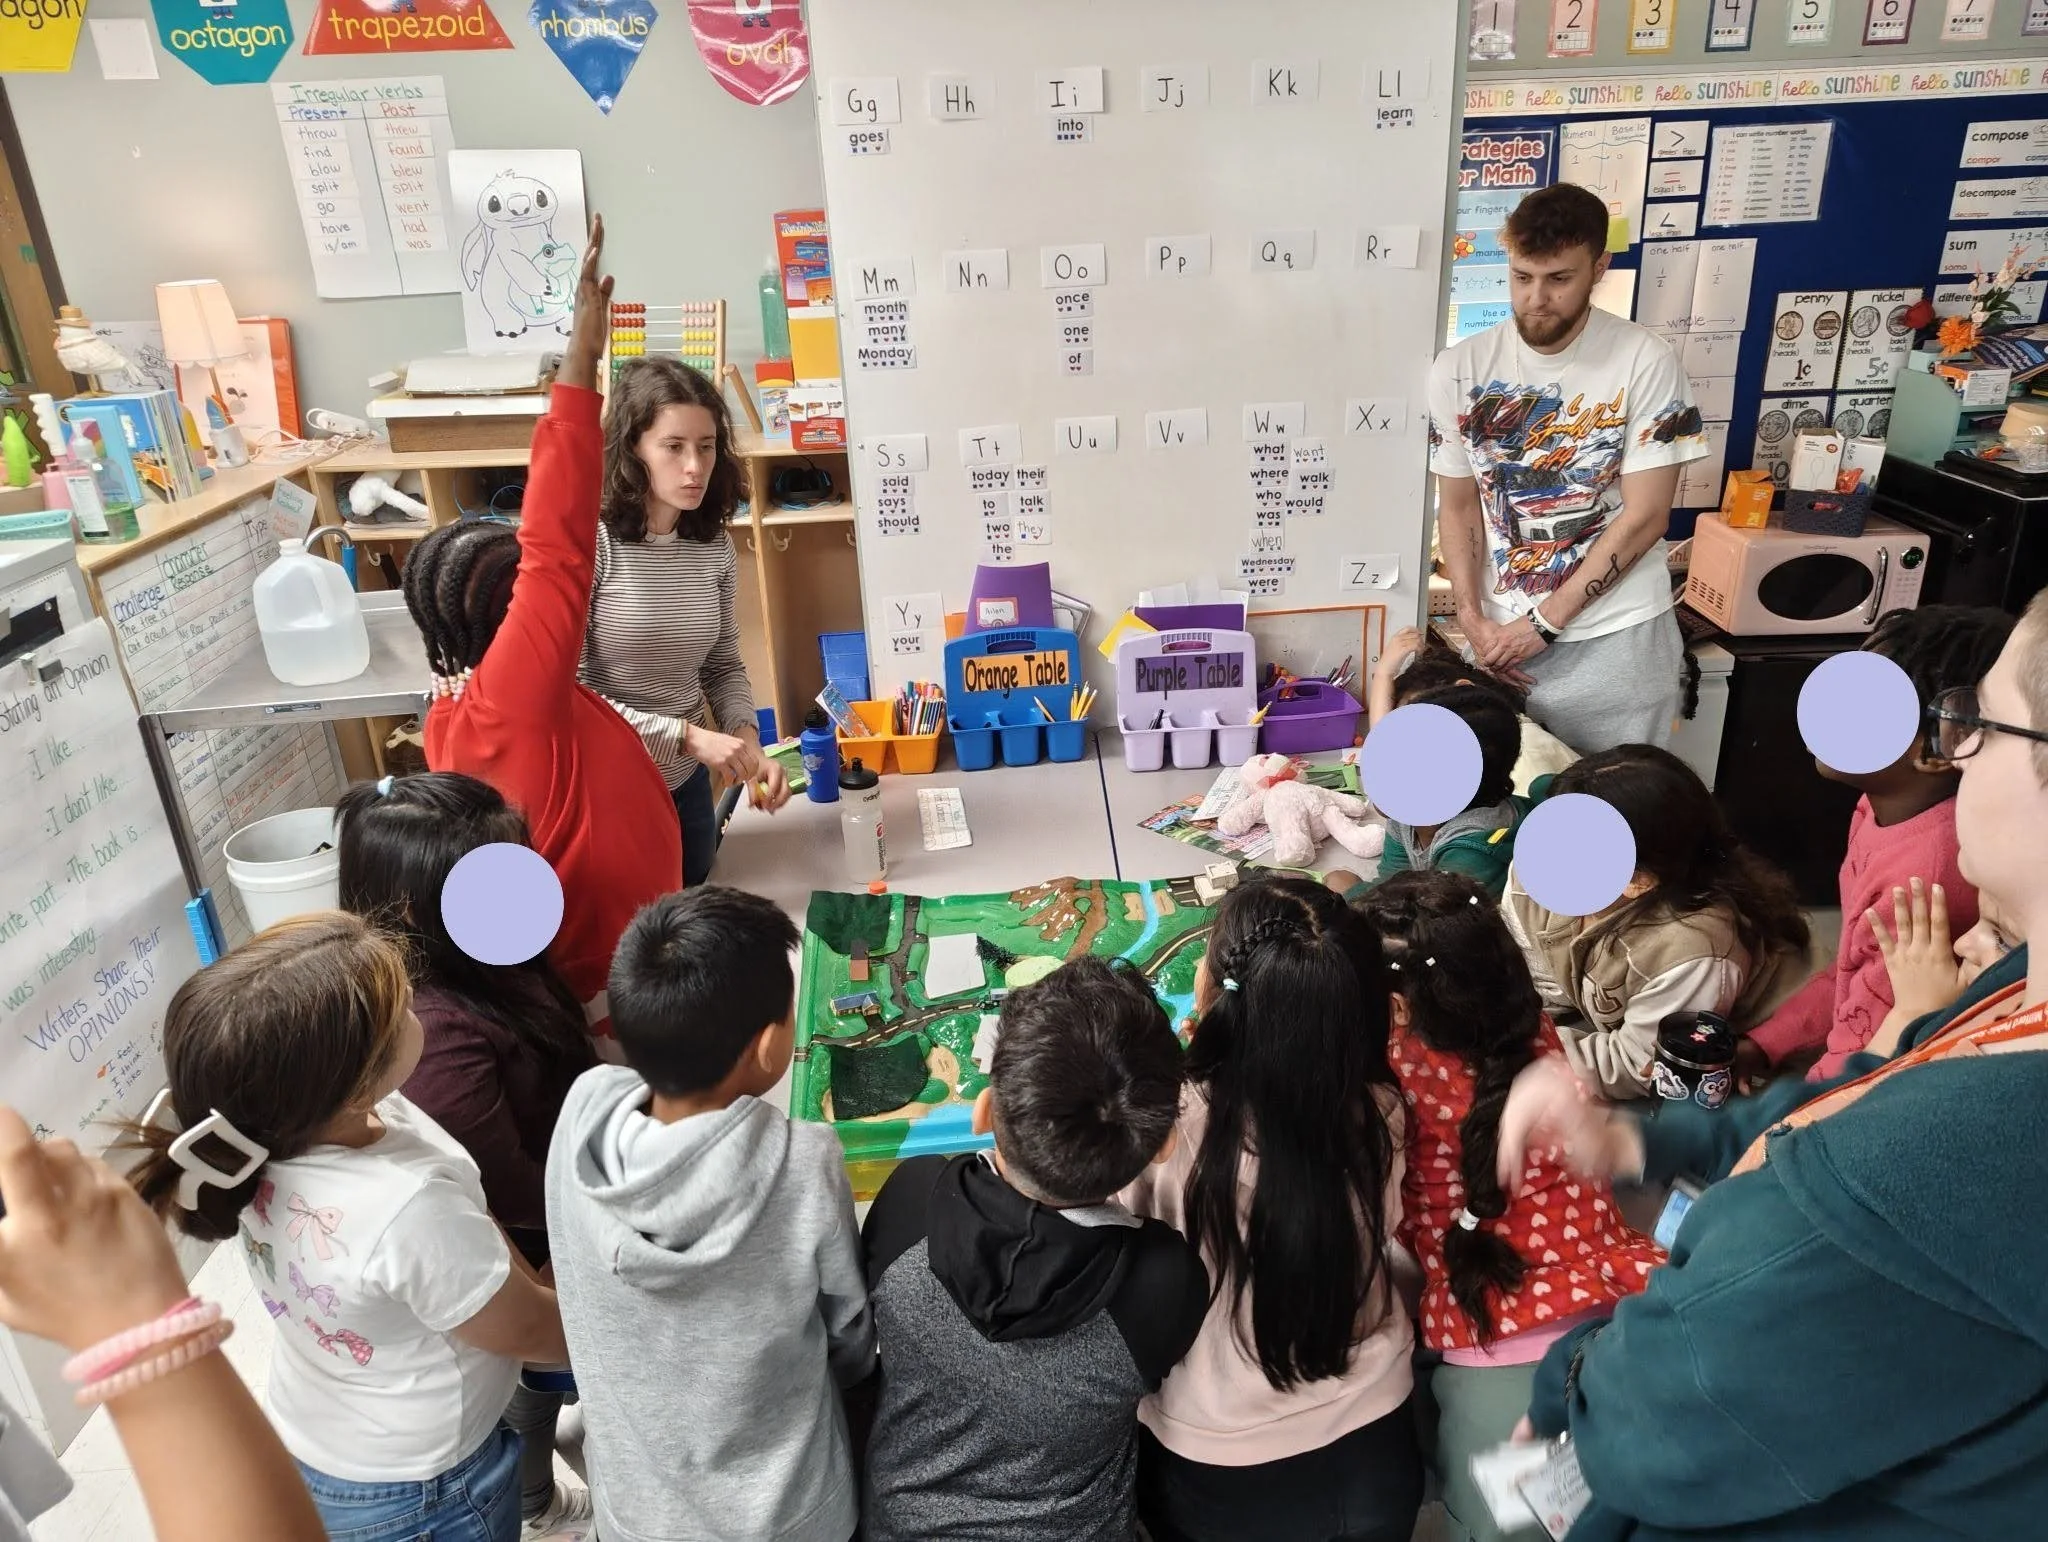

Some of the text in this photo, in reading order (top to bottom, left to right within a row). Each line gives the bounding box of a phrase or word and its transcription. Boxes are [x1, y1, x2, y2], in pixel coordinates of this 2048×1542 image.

[1566, 0, 1581, 28] 2
[1645, 0, 1661, 25] 3
[328, 10, 486, 49] trapezoid
[541, 11, 648, 39] rhombus
[171, 23, 286, 58] octagon
[727, 34, 792, 67] oval
[1525, 68, 2030, 106] hello sunshine hello sunshine hello sunshine hello sunshine
[289, 84, 369, 106] Irregular
[288, 102, 416, 120] Present Past
[1377, 106, 1414, 122] learn
[386, 123, 419, 135] threw
[1057, 118, 1084, 133] into
[1611, 125, 1636, 137] Base
[299, 126, 338, 140] throw
[849, 130, 885, 148] goes
[1971, 129, 2030, 145] compose
[304, 146, 332, 159] find
[391, 163, 422, 178] blew
[1483, 163, 1536, 186] Math
[312, 180, 339, 195] split
[1959, 186, 2018, 199] decompose
[318, 201, 336, 216] go
[397, 202, 430, 214] went
[1475, 204, 1509, 217] fingers
[320, 220, 351, 235] have
[401, 218, 428, 233] had
[407, 239, 432, 250] was
[1949, 238, 1978, 251] sum
[1054, 290, 1091, 306] once
[1794, 293, 1834, 306] penny
[1871, 291, 1906, 303] nickel
[864, 301, 908, 314] month
[868, 323, 908, 338] many
[1063, 324, 1090, 336] one
[858, 346, 914, 360] Monday
[1067, 352, 1083, 365] of
[1781, 399, 1810, 410] dime
[1848, 395, 1893, 407] quarter
[1253, 443, 1286, 455] what
[972, 468, 1046, 483] today their
[1250, 467, 1290, 480] where
[1299, 471, 1330, 484] walk
[882, 475, 910, 488] said
[1020, 494, 1045, 507] talk
[1255, 488, 1283, 501] who
[877, 496, 907, 510] says
[983, 498, 996, 510] to
[1285, 495, 1324, 509] would
[877, 515, 921, 528] should
[1256, 510, 1282, 521] was
[245, 519, 269, 543] Type
[986, 521, 1011, 534] two
[1017, 520, 1044, 538] they
[1251, 529, 1283, 548] when
[992, 543, 1013, 555] the
[1241, 555, 1296, 569] Wednesday
[1247, 576, 1280, 589] were
[892, 635, 920, 648] your
[965, 654, 1068, 699] Orange Table
[1137, 652, 1243, 701] Purple Table
[0, 652, 112, 734] Stating an Opinion
[28, 748, 46, 782] I
[46, 805, 62, 837] I
[67, 831, 124, 885] The book
[3, 979, 35, 1013] was
[23, 926, 162, 1052] Writers Share Their
